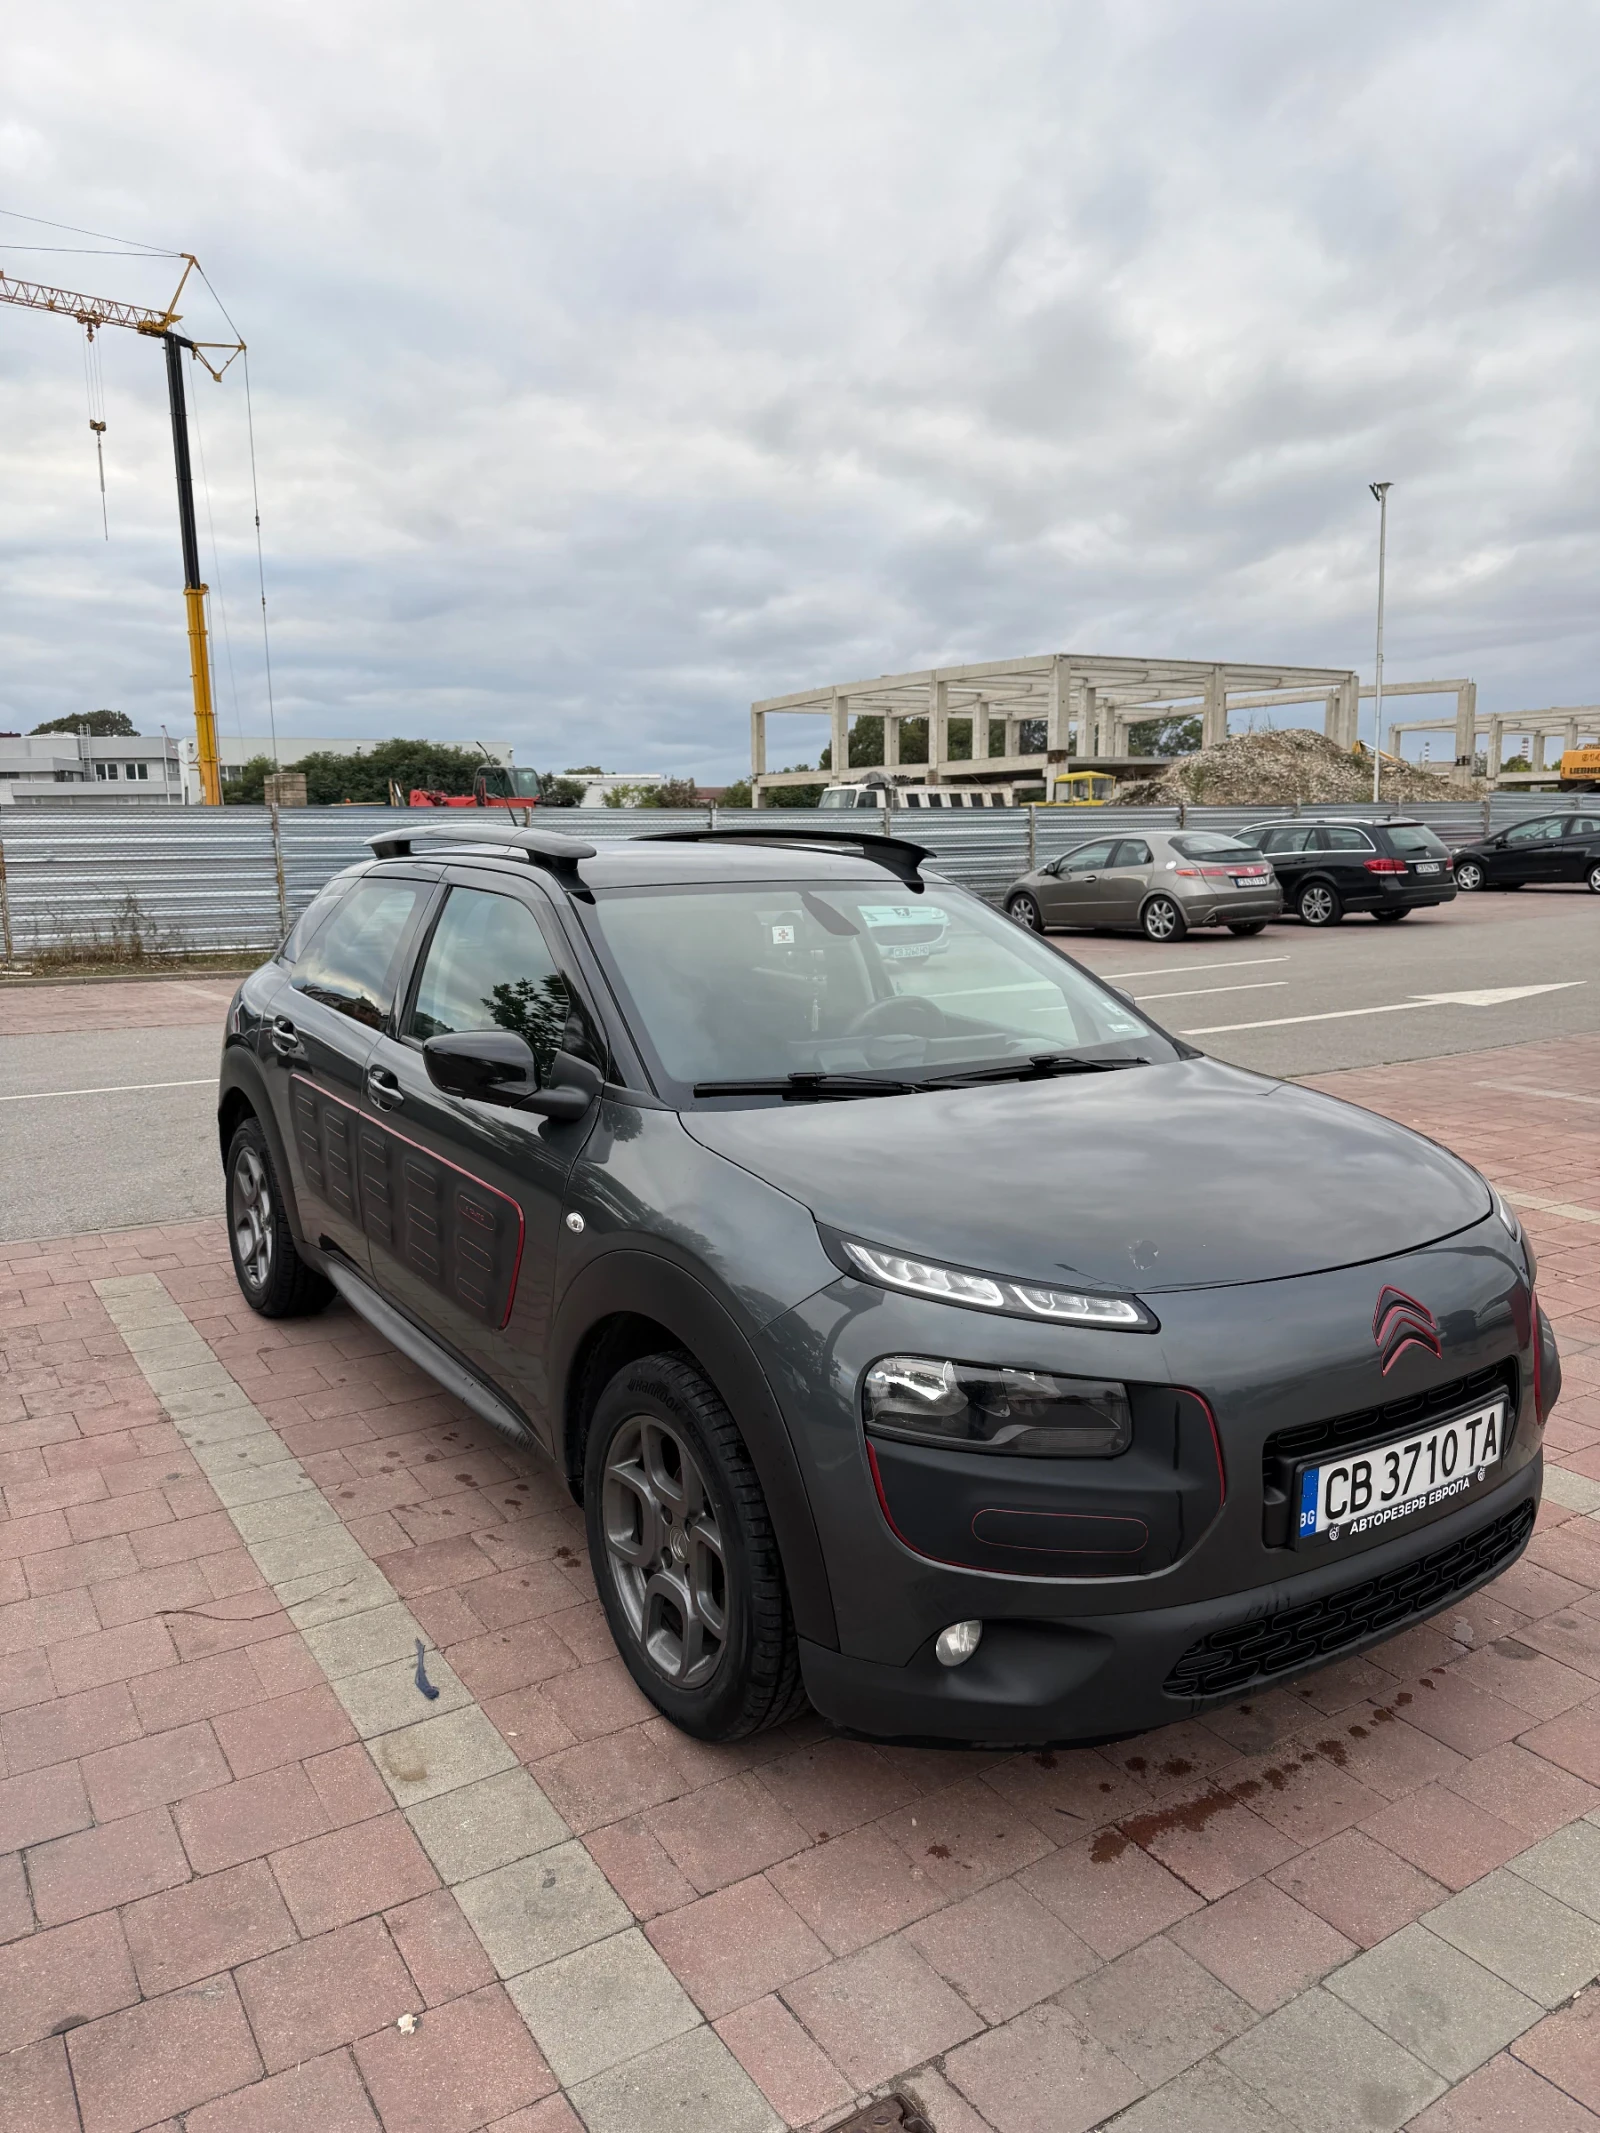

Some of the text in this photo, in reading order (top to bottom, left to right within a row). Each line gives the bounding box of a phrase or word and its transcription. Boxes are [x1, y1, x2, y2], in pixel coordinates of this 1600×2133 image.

[1324, 1411, 1497, 1520] CB 3710 TA
[1350, 1496, 1426, 1535] АВТОРЕЗЕРВ
[1429, 1476, 1470, 1505] ЕВРОПА
